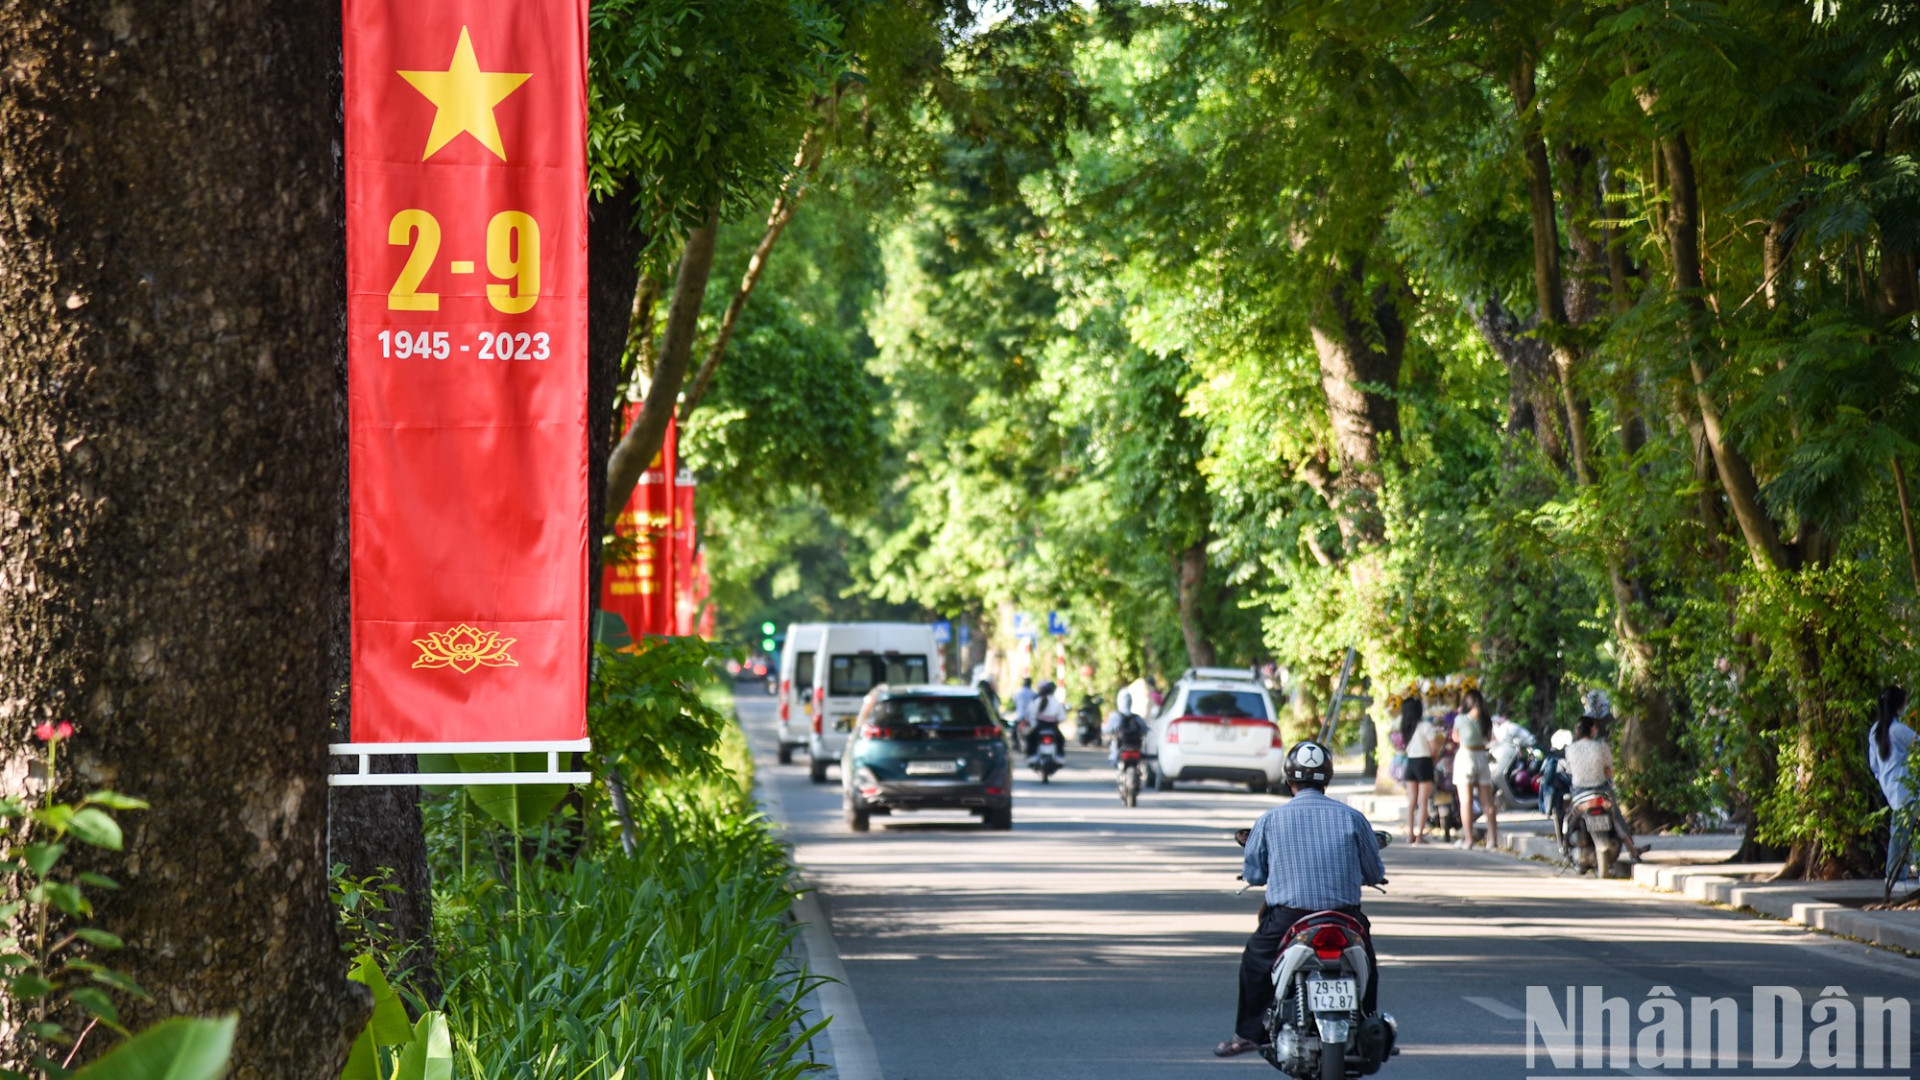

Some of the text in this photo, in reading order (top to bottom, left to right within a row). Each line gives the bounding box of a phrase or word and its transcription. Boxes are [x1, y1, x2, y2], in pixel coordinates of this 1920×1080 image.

[378, 330, 450, 360] 1945
[478, 331, 550, 361] 2023
[1313, 995, 1353, 1009] 142.87
